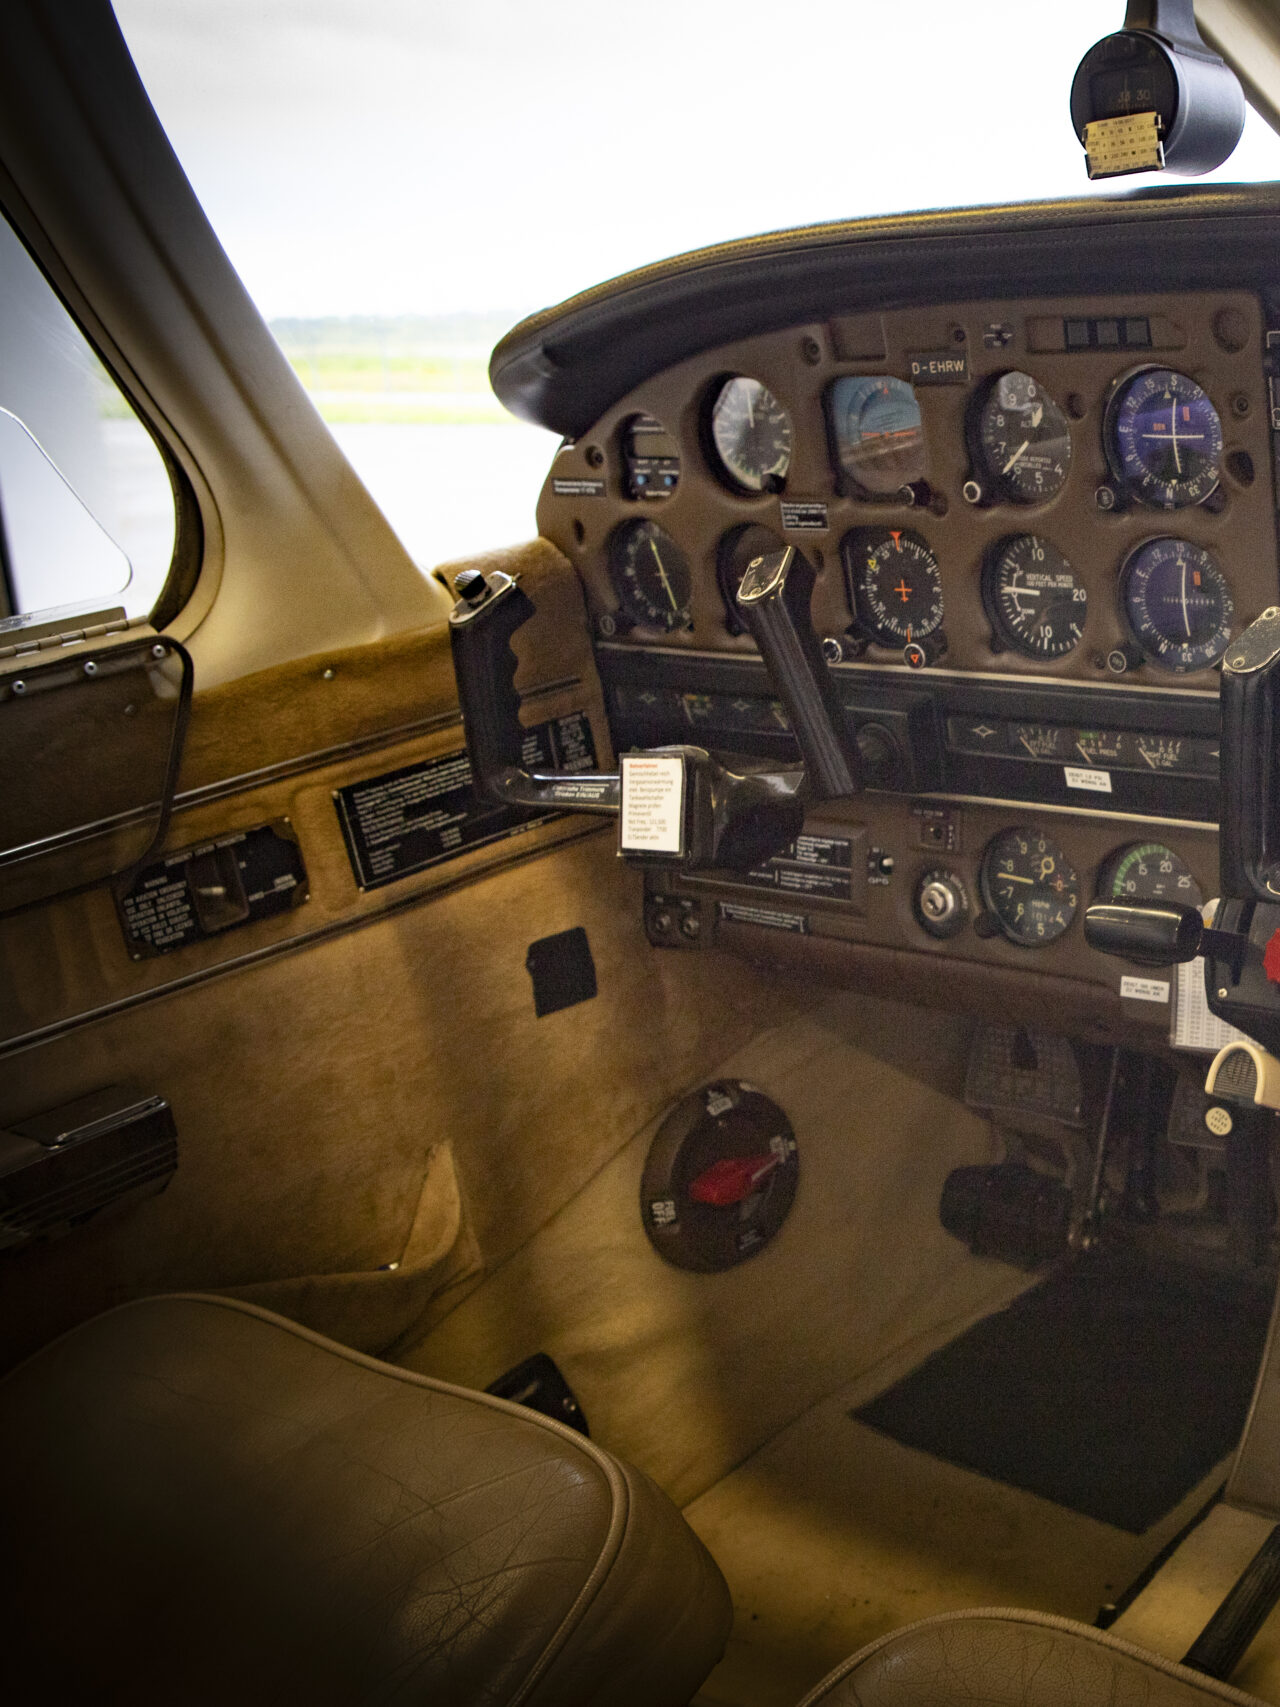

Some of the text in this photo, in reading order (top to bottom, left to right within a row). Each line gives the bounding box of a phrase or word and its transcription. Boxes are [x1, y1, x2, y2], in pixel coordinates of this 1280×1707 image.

[911, 360, 964, 375] D-EHRW
[1171, 376, 1177, 386] S
[1027, 385, 1036, 397] 0
[1007, 393, 1017, 406] 9
[997, 415, 1005, 427] 8
[998, 442, 1006, 453] 7
[1054, 463, 1062, 474] 4
[1035, 472, 1043, 484] 5
[1166, 488, 1173, 499] N
[1189, 485, 1200, 496] 33
[1176, 543, 1185, 552] 15
[1032, 548, 1044, 560] 10
[1026, 573, 1073, 583] VERTICAL SPEED
[1073, 590, 1086, 602] 20
[1040, 625, 1052, 638] 10
[1182, 652, 1192, 662] 33
[1039, 840, 1045, 852] 0
[1139, 864, 1147, 876] 15
[1160, 861, 1172, 873] 20
[868, 876, 889, 885] GPS
[1126, 881, 1136, 892] 10
[1178, 875, 1190, 888] 25
[1007, 886, 1014, 898] 7
[1069, 894, 1076, 907] 3
[1017, 903, 1024, 915] 6
[1056, 911, 1062, 922] 4
[1038, 923, 1044, 936] 5
